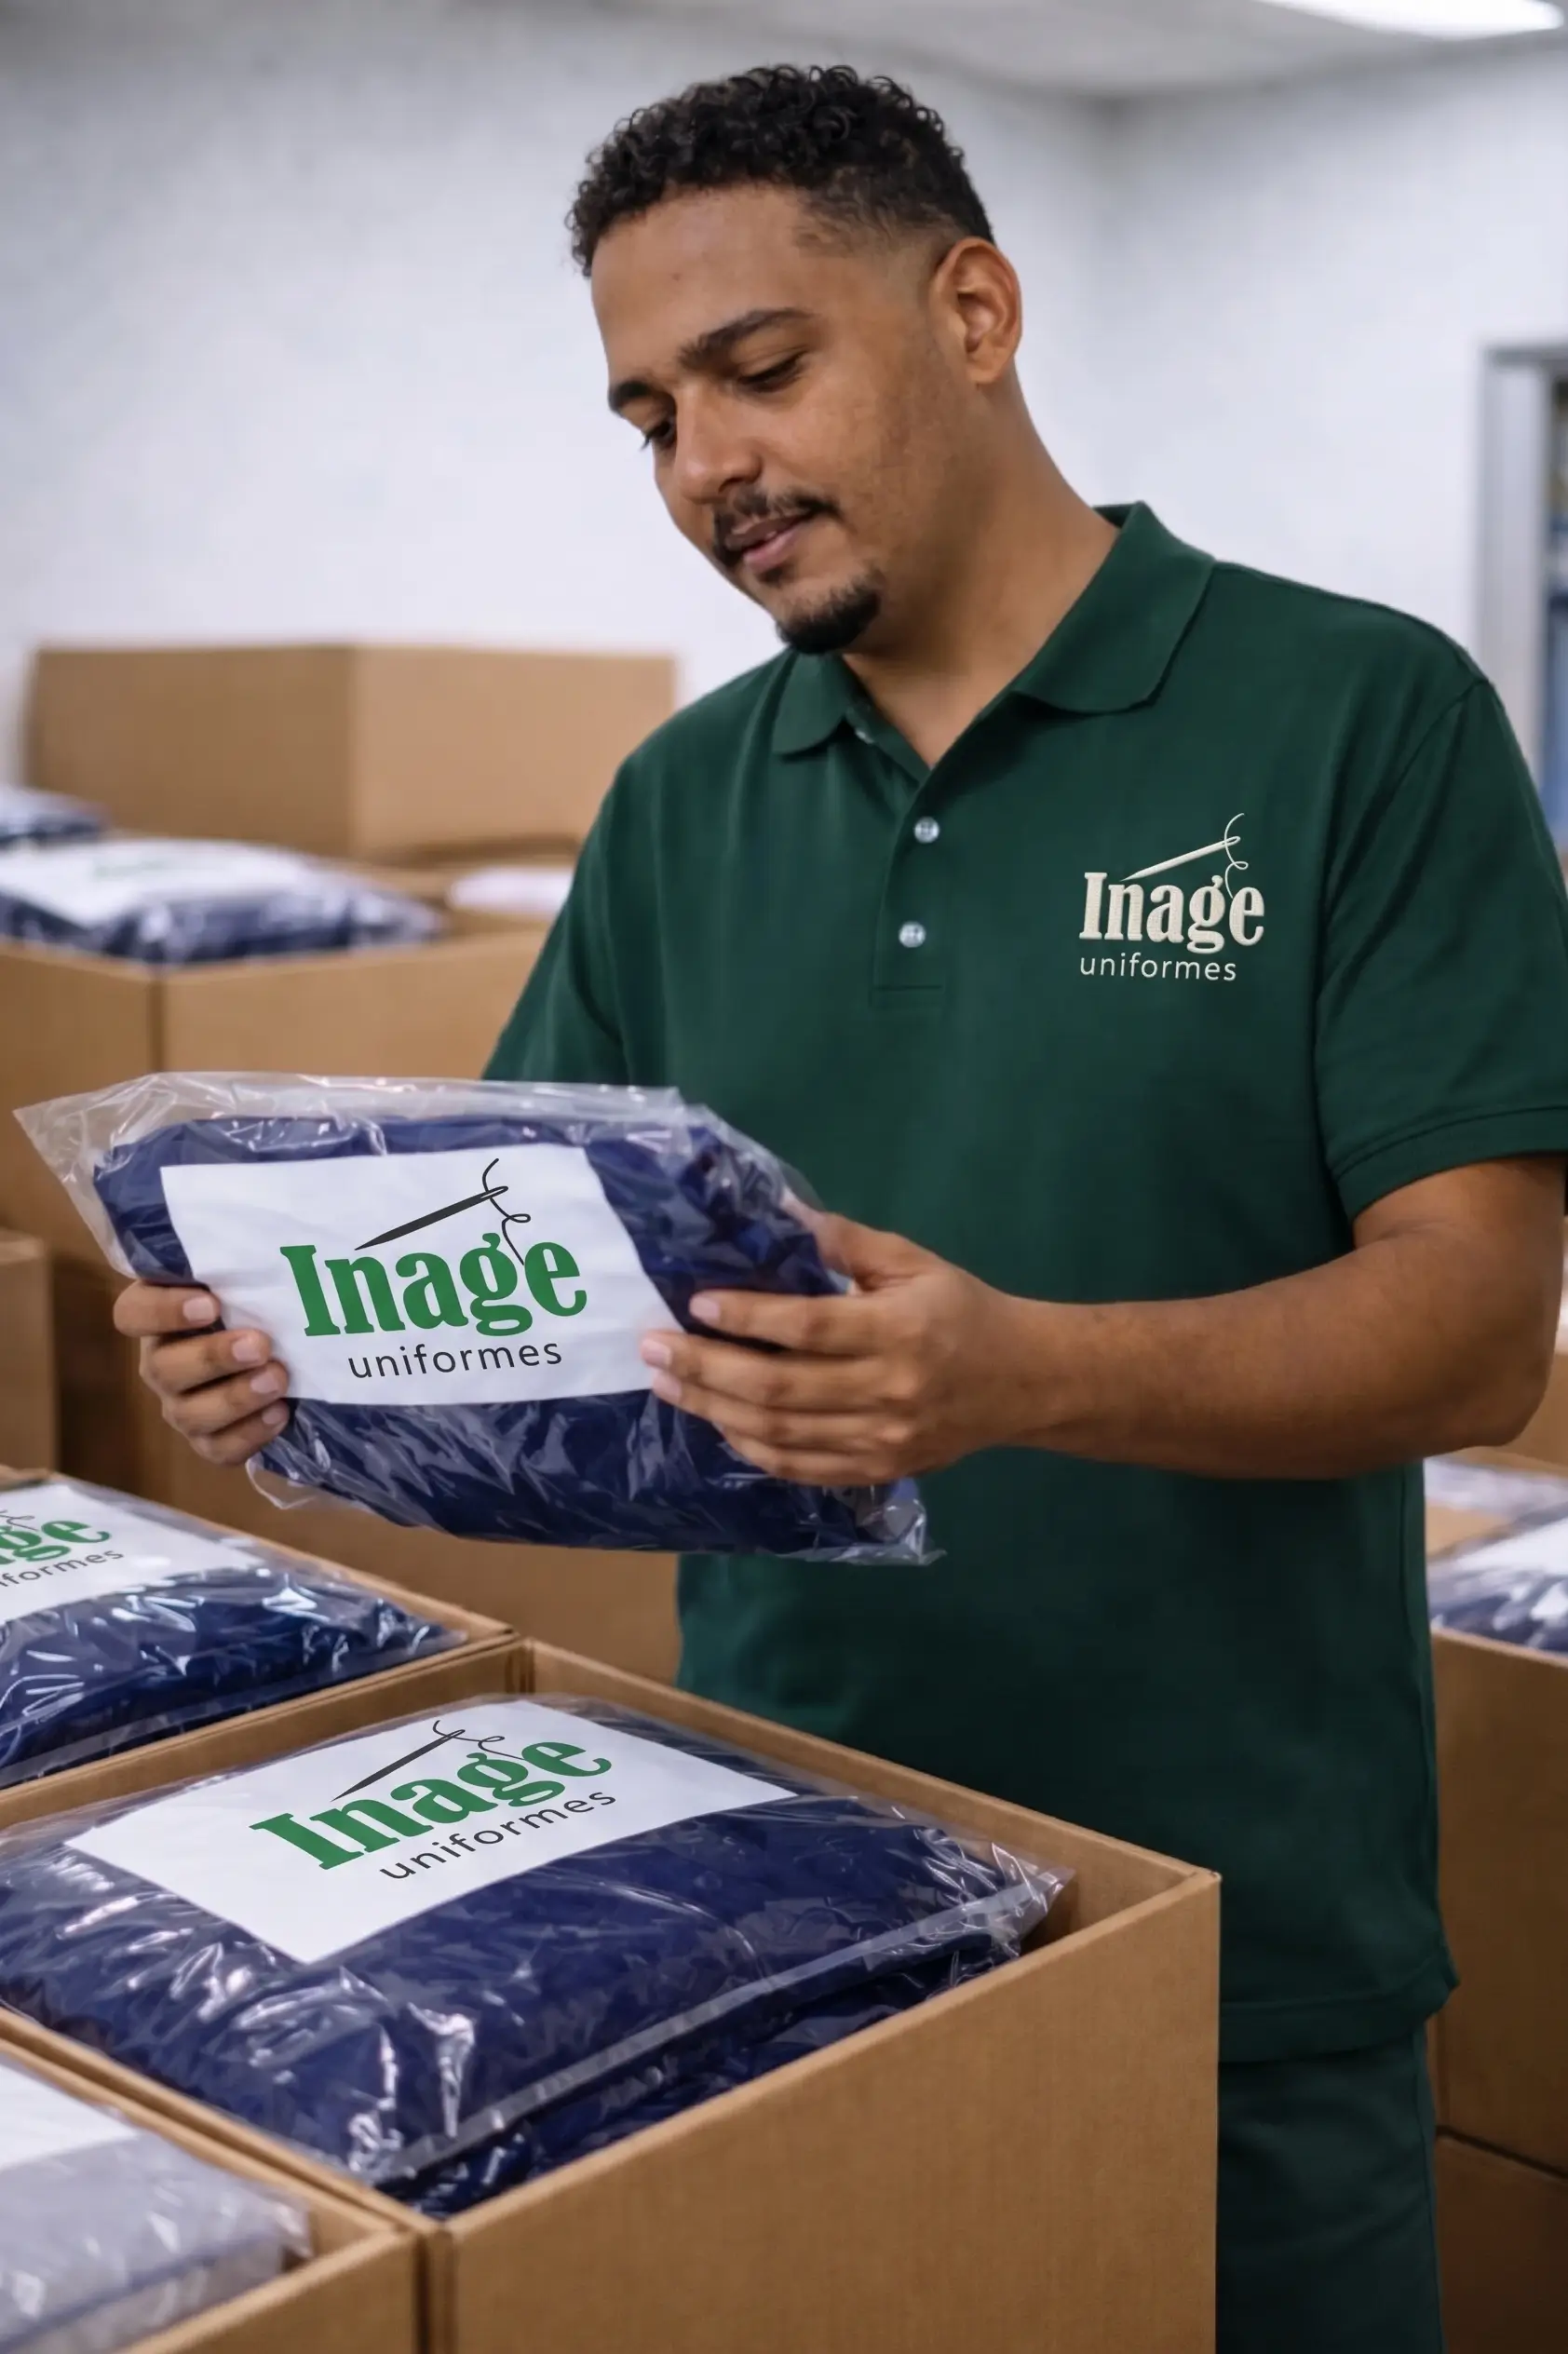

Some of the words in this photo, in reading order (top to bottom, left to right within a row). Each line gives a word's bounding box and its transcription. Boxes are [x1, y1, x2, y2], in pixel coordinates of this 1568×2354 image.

[1079, 872, 1264, 954] Inage
[1080, 952, 1237, 981] uniformes
[279, 1233, 588, 1337] Inage
[347, 1343, 562, 1379] uniformes
[250, 1741, 613, 1871] Inage
[379, 1791, 616, 1879] uniformes
